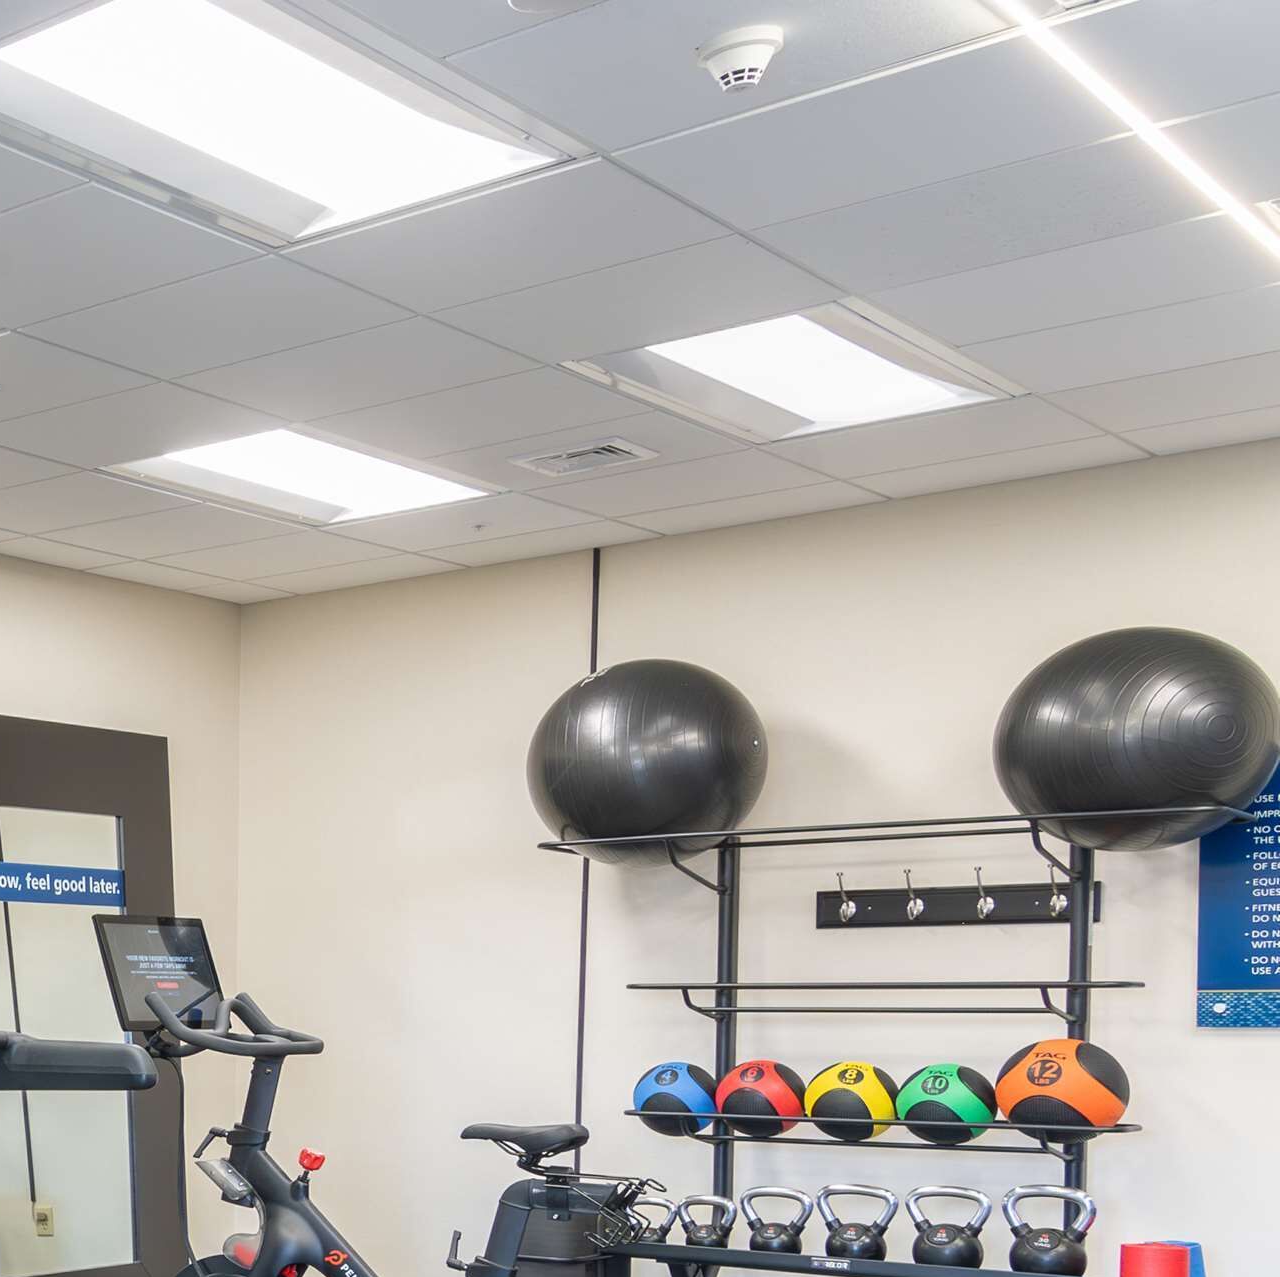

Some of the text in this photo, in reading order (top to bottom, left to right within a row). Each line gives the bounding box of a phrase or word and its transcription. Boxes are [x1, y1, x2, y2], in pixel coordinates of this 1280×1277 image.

[1254, 809, 1280, 818] IMPR
[1253, 825, 1271, 834] NO
[1253, 836, 1274, 844] THE
[1253, 851, 1280, 860] FOLL
[1253, 862, 1268, 871] OF
[26, 872, 51, 891] feel
[54, 876, 86, 895] good
[90, 876, 120, 895] later.
[1252, 878, 1280, 887] EQUI
[1252, 888, 1280, 896] GUES
[1252, 904, 1280, 912] FITNE
[1252, 914, 1269, 923] DO
[1251, 930, 1269, 938] DO
[1251, 956, 1269, 964] DO
[1251, 967, 1272, 975] USE
[1032, 1052, 1067, 1060] TAG
[747, 1067, 758, 1078] 6
[1031, 1061, 1059, 1078] 12
[661, 1070, 673, 1081] 4
[845, 1069, 858, 1080] 8
[925, 1077, 947, 1090] 10
